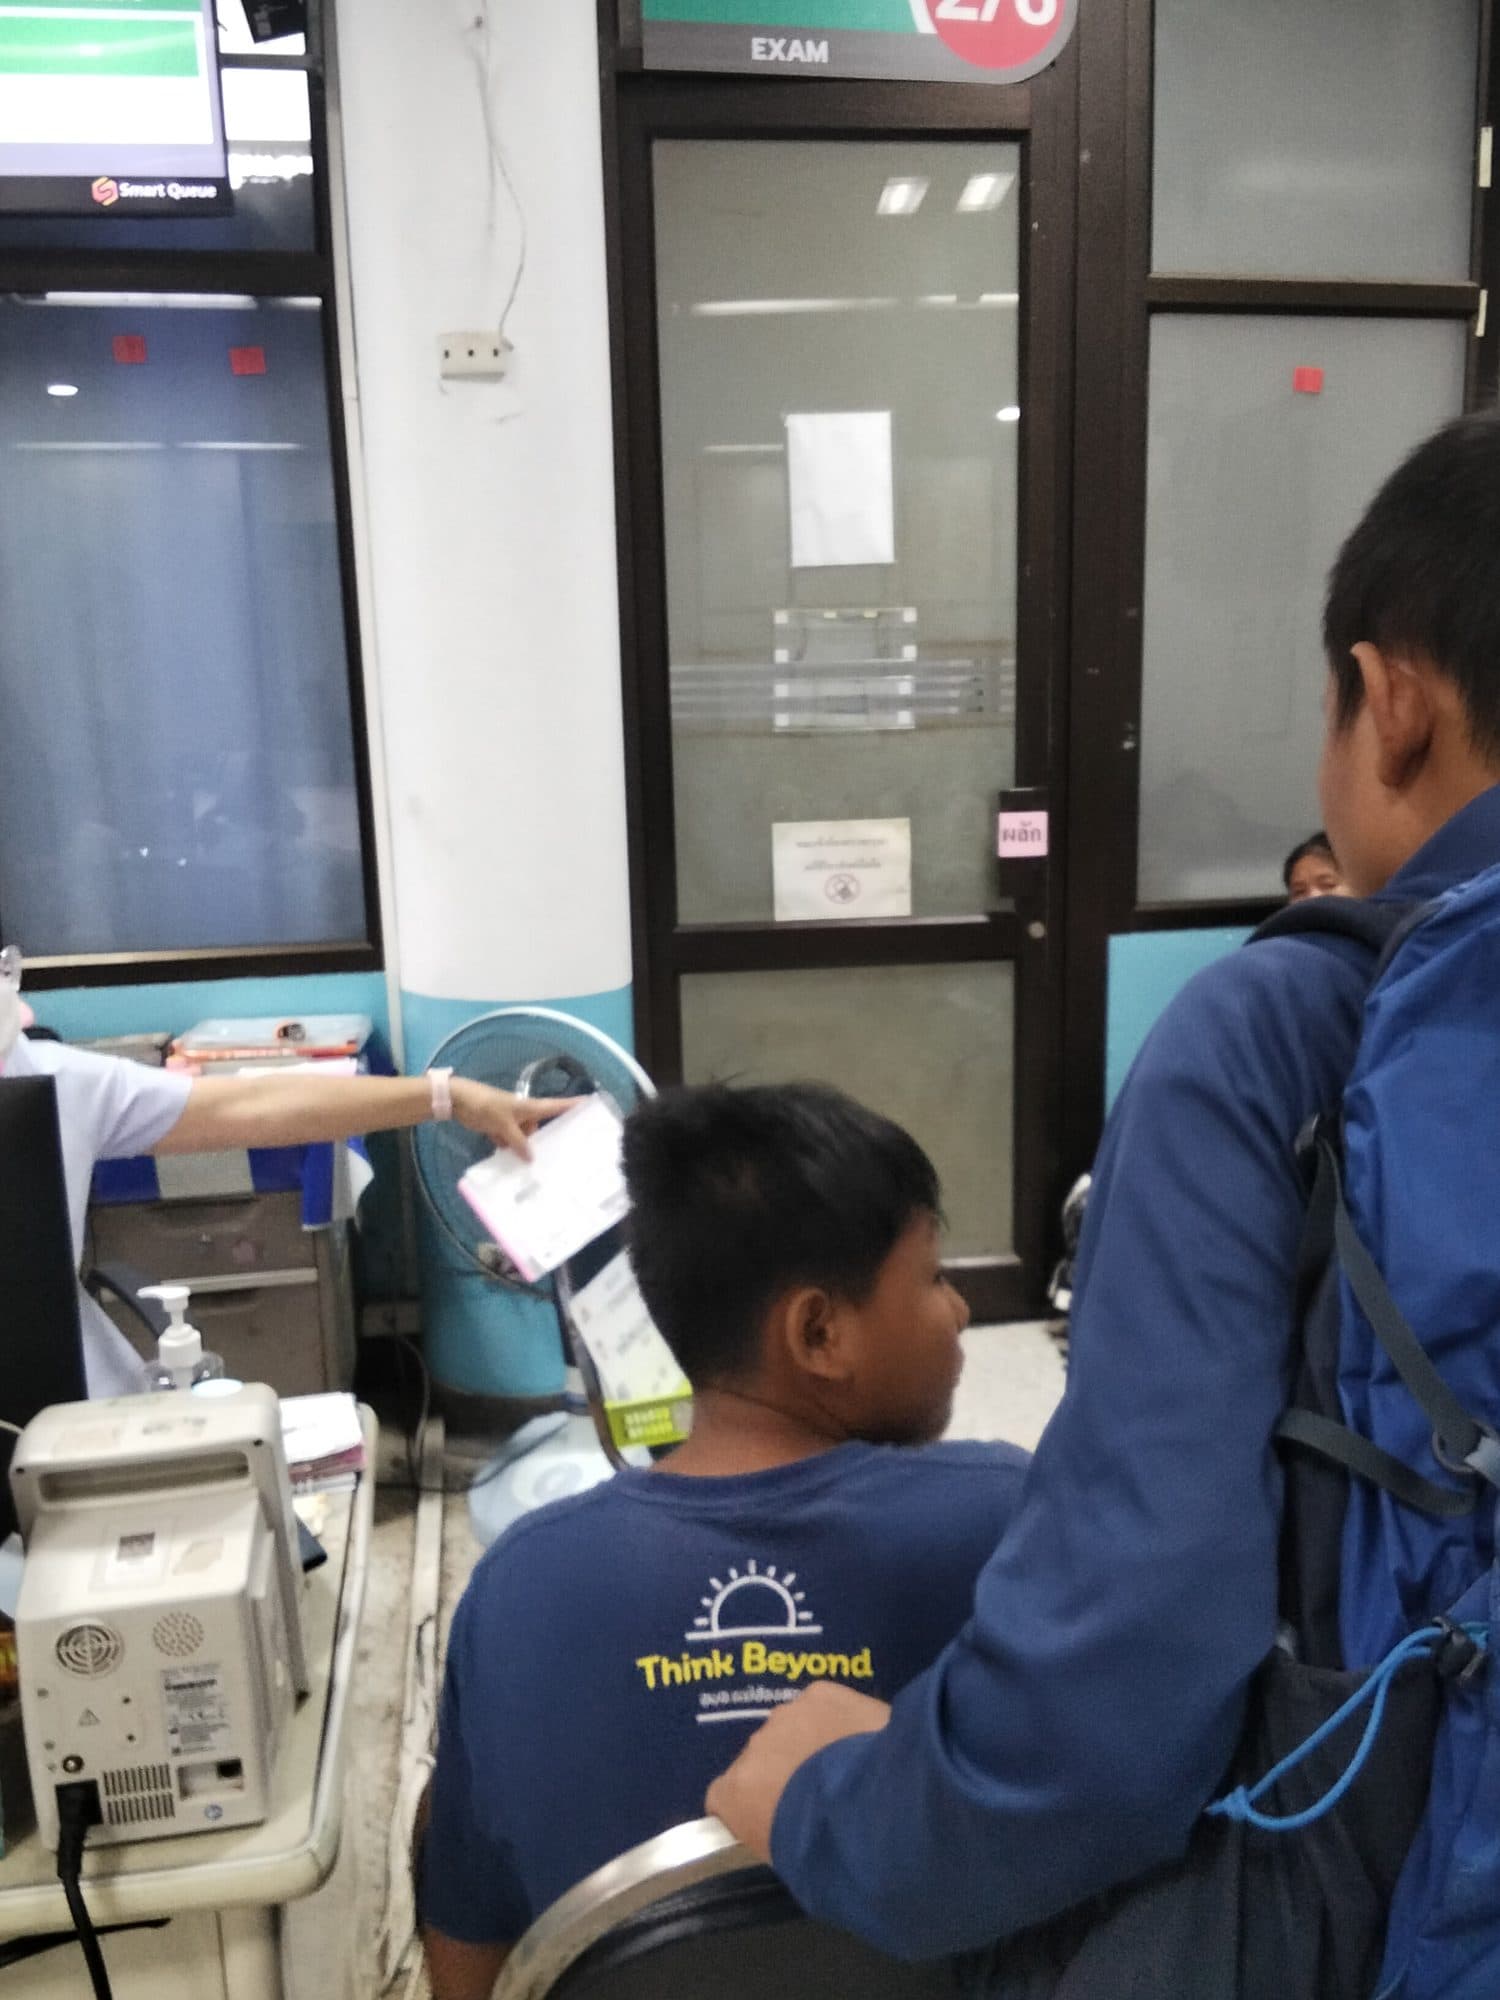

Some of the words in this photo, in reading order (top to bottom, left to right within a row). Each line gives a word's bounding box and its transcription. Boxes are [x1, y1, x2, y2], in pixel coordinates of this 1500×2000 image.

[750, 37, 830, 64] EXAM
[119, 182, 166, 198] Smart
[166, 182, 218, 200] Queue
[635, 1649, 736, 1691] Think
[741, 1641, 874, 1681] Beyond
